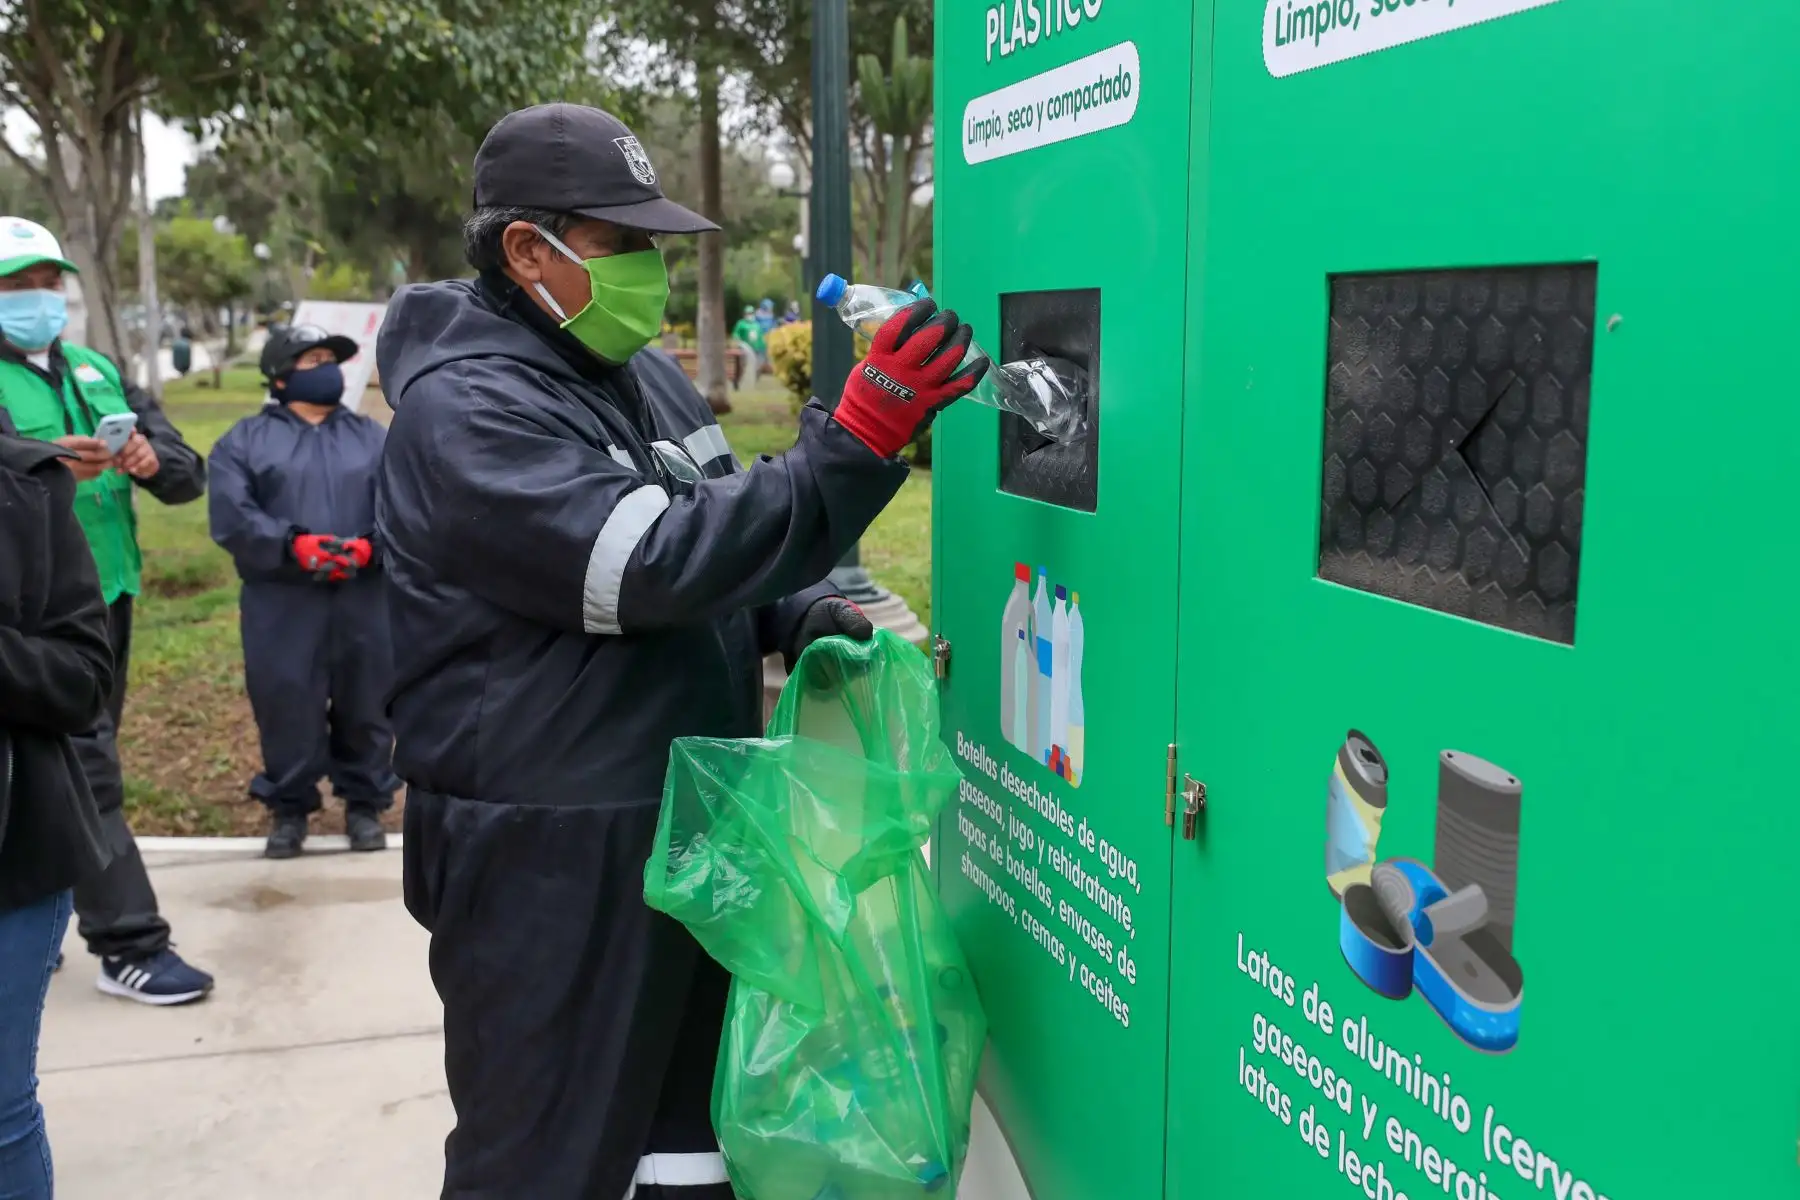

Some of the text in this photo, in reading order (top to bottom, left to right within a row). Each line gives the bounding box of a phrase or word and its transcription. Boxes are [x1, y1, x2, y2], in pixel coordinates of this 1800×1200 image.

[967, 63, 1132, 147] Limpio, seco y compactado
[1276, 0, 1360, 47] Limpio,
[957, 731, 1141, 894] Botellas desechables de agua,
[959, 777, 1136, 939] gaseosa, jugo y rehidratante,
[958, 809, 1136, 984] tapas de botellas, envases de
[961, 851, 1129, 1028] shampoos, cremas y aceites
[1237, 932, 1612, 1200] Latas de aluminio (cerv
[1239, 1047, 1409, 1200] latas de lech
[1252, 1012, 1502, 1200] gaseosa y energi
